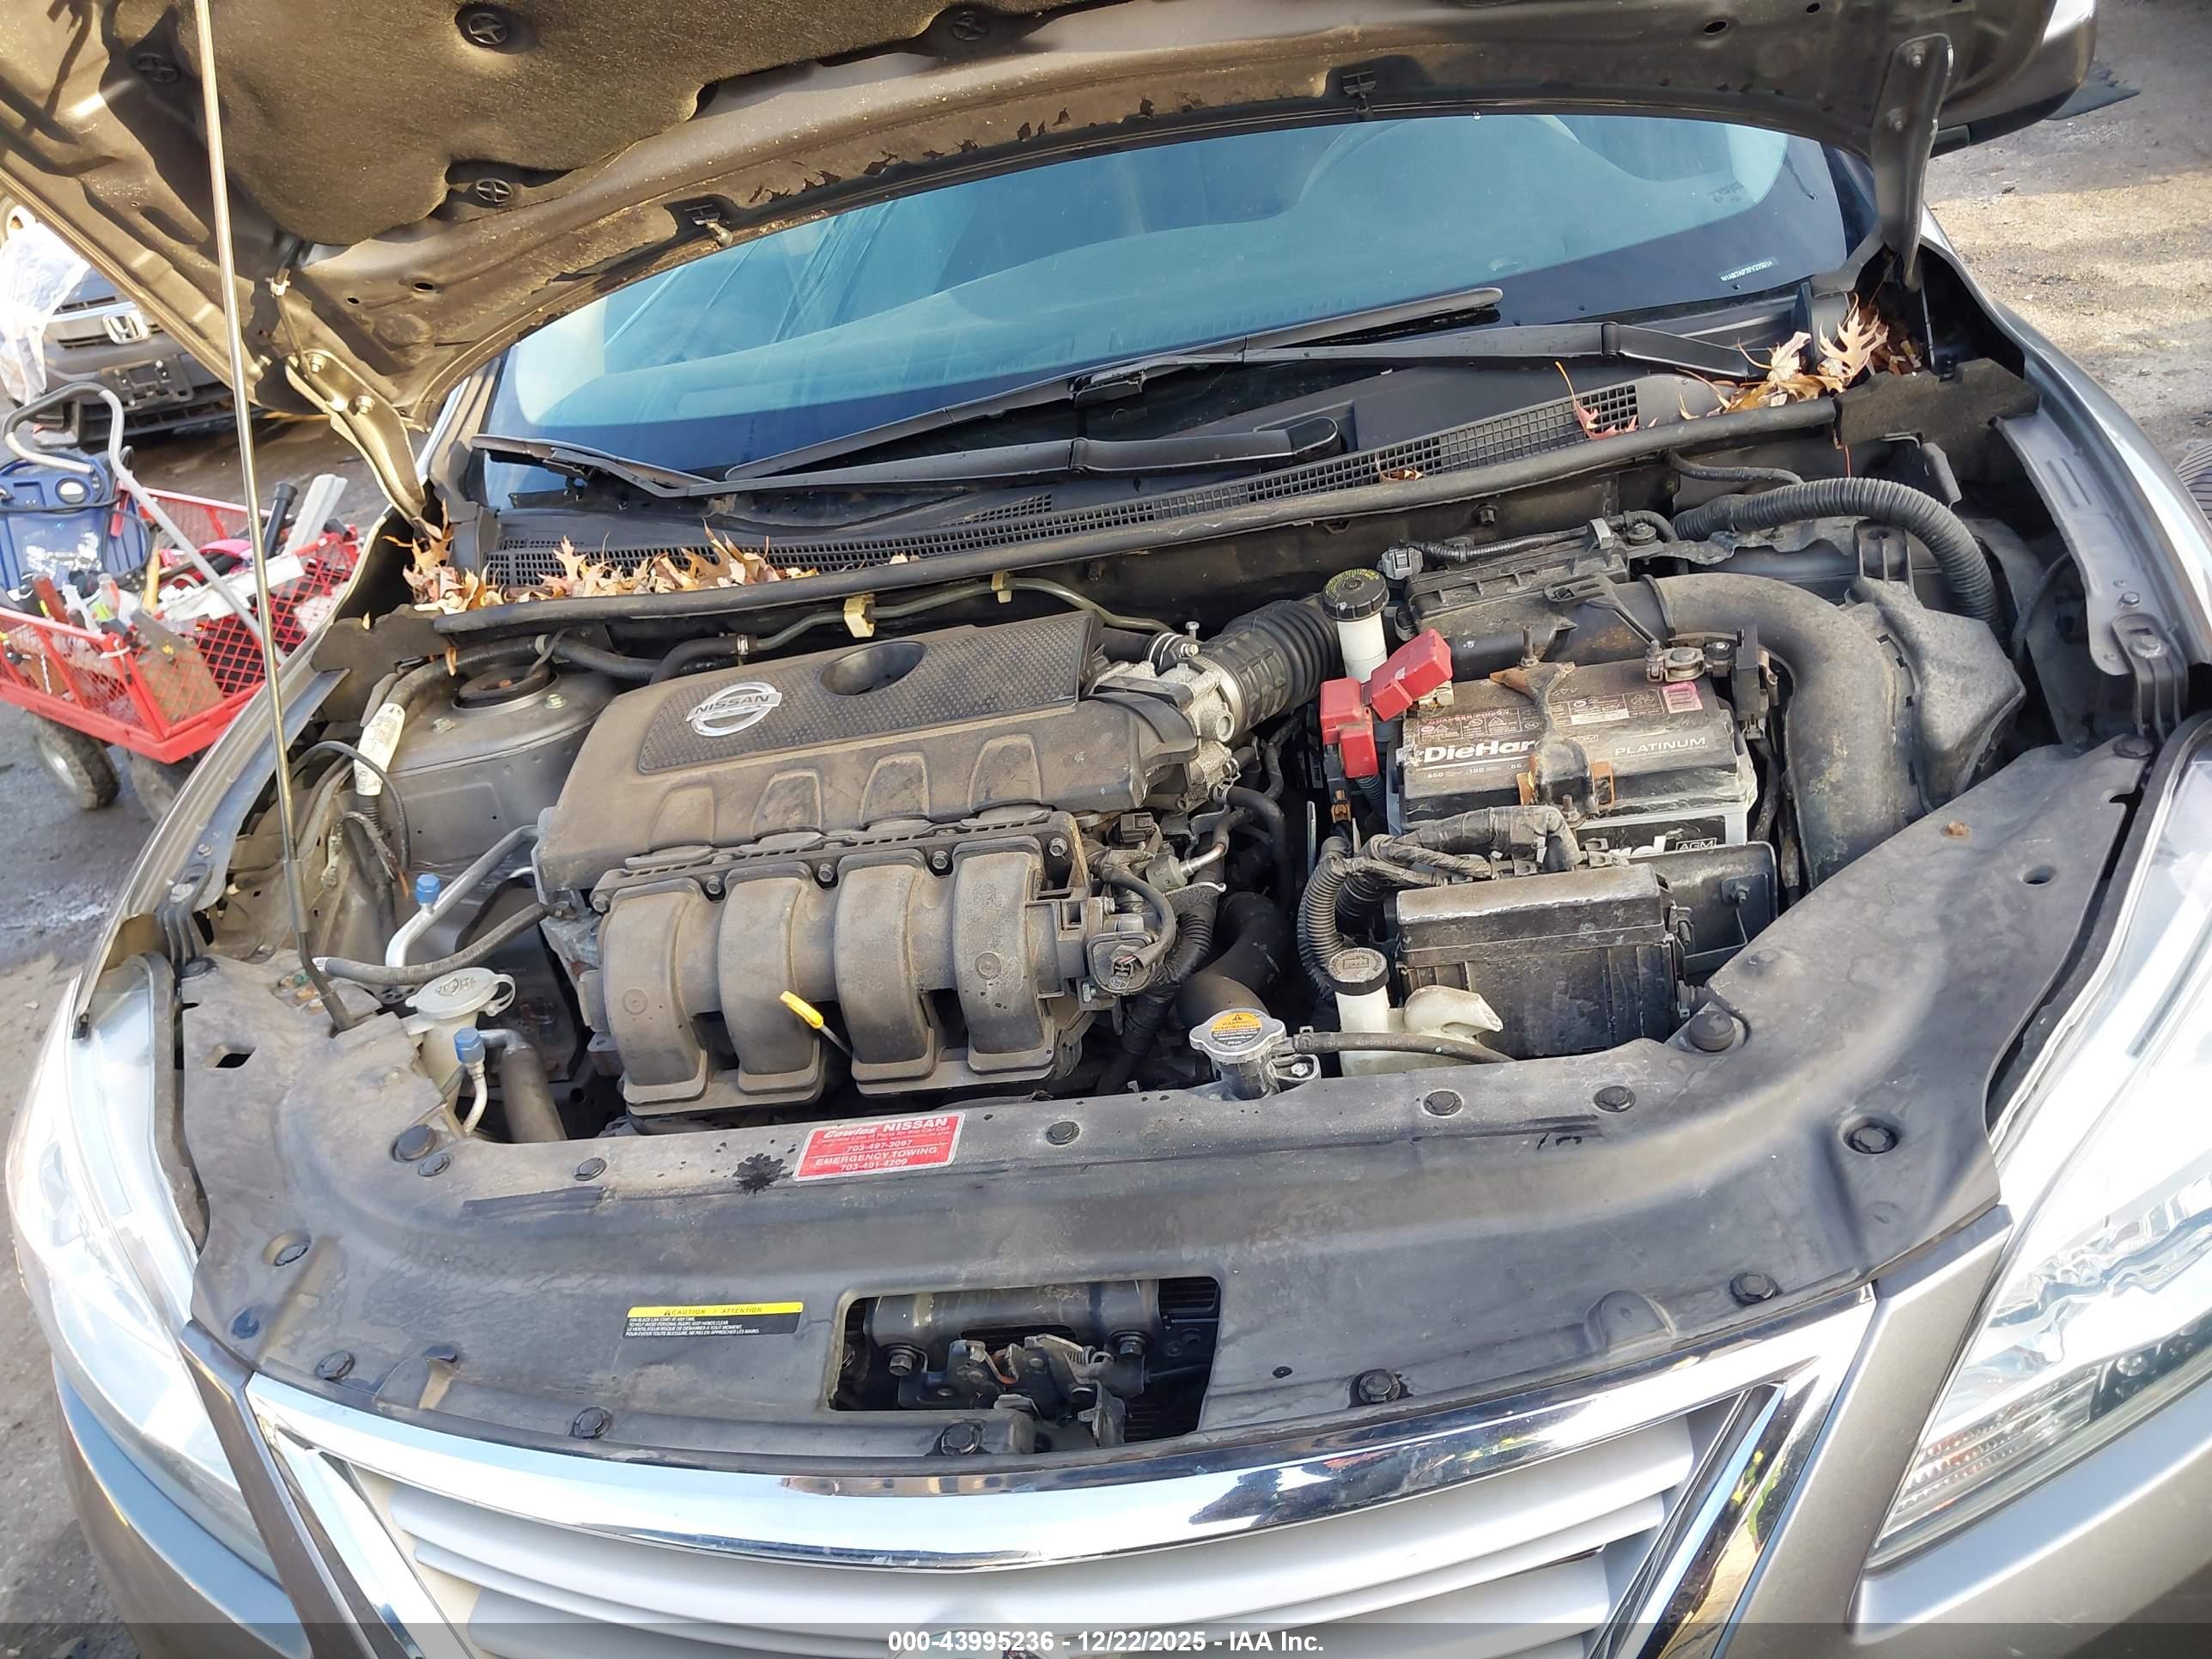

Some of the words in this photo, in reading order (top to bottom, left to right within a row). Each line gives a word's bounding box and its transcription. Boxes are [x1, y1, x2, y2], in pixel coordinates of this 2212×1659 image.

[695, 695, 770, 714] NISSAN
[1424, 739, 1540, 763] DieHar
[1614, 737, 1706, 756] PLATINUM
[1679, 840, 1714, 852] AGM
[883, 1118, 949, 1133] NISSAN
[816, 1152, 890, 1166] EMERGENCY
[891, 1146, 938, 1158] TOWING
